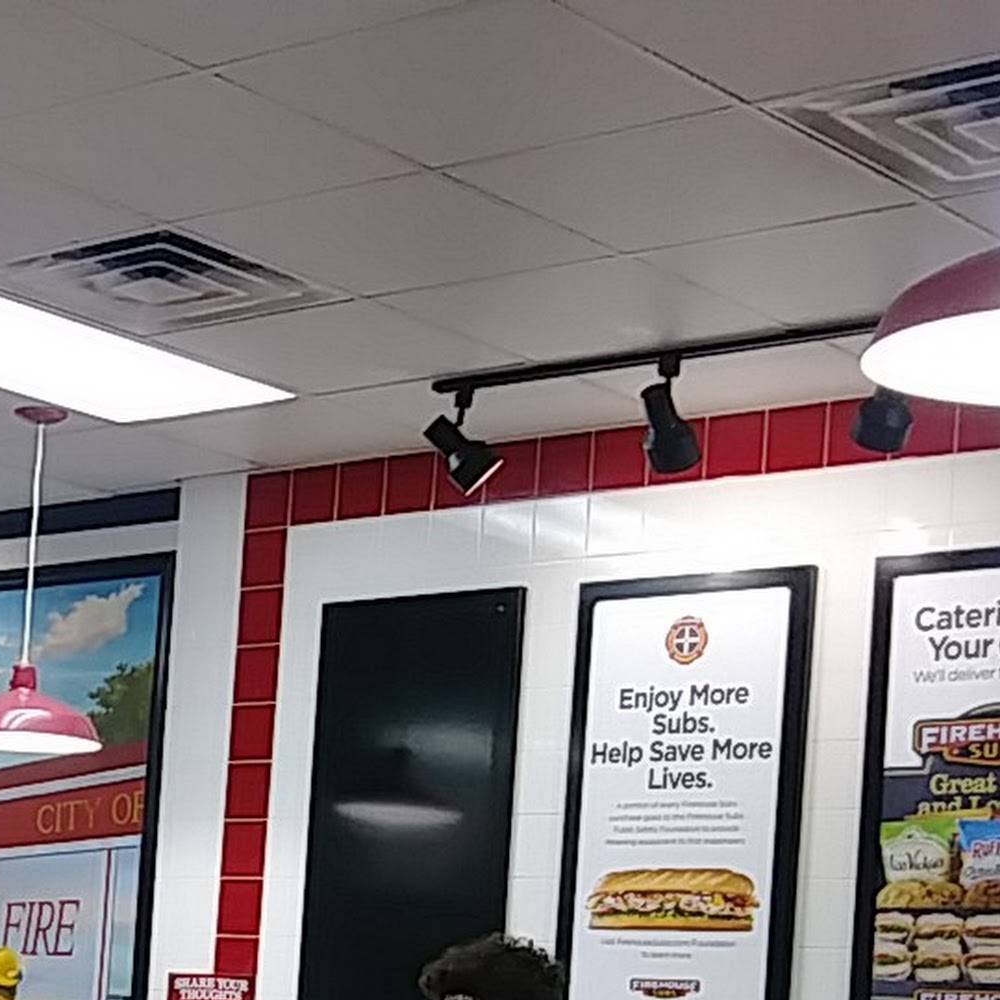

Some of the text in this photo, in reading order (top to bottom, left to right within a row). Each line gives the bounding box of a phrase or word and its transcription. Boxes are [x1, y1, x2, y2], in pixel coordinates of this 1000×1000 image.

[928, 635, 994, 662] Your
[948, 668, 996, 682] deliver
[619, 683, 750, 713] Enjoy More
[652, 711, 715, 735] Subs.
[590, 738, 773, 767] Help Save More
[648, 766, 713, 789] Lives.
[929, 771, 998, 796] Great
[36, 798, 101, 834] CITY
[2, 899, 81, 956] FIRE
[174, 976, 249, 992] SHARE YOUR
